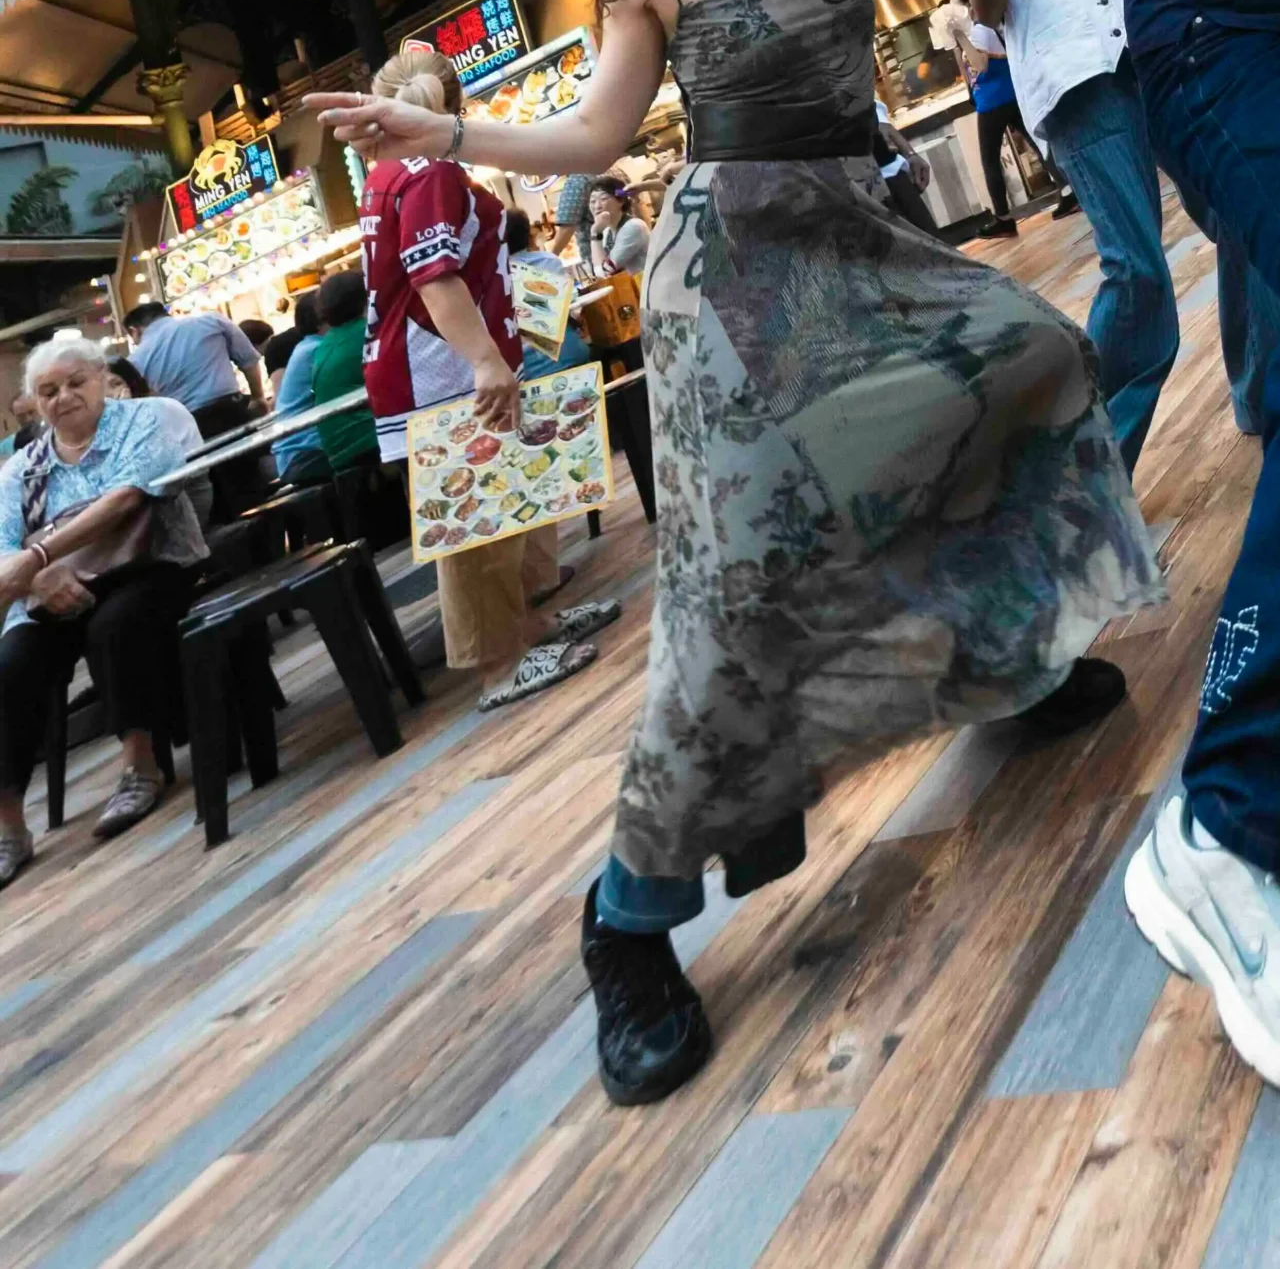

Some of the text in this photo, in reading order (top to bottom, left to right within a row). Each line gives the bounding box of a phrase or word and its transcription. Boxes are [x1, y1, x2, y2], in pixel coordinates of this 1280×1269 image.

[487, 25, 520, 52] YEN
[476, 47, 517, 75] SEAFOOD
[194, 184, 226, 212] MING
[228, 169, 252, 192] YEN
